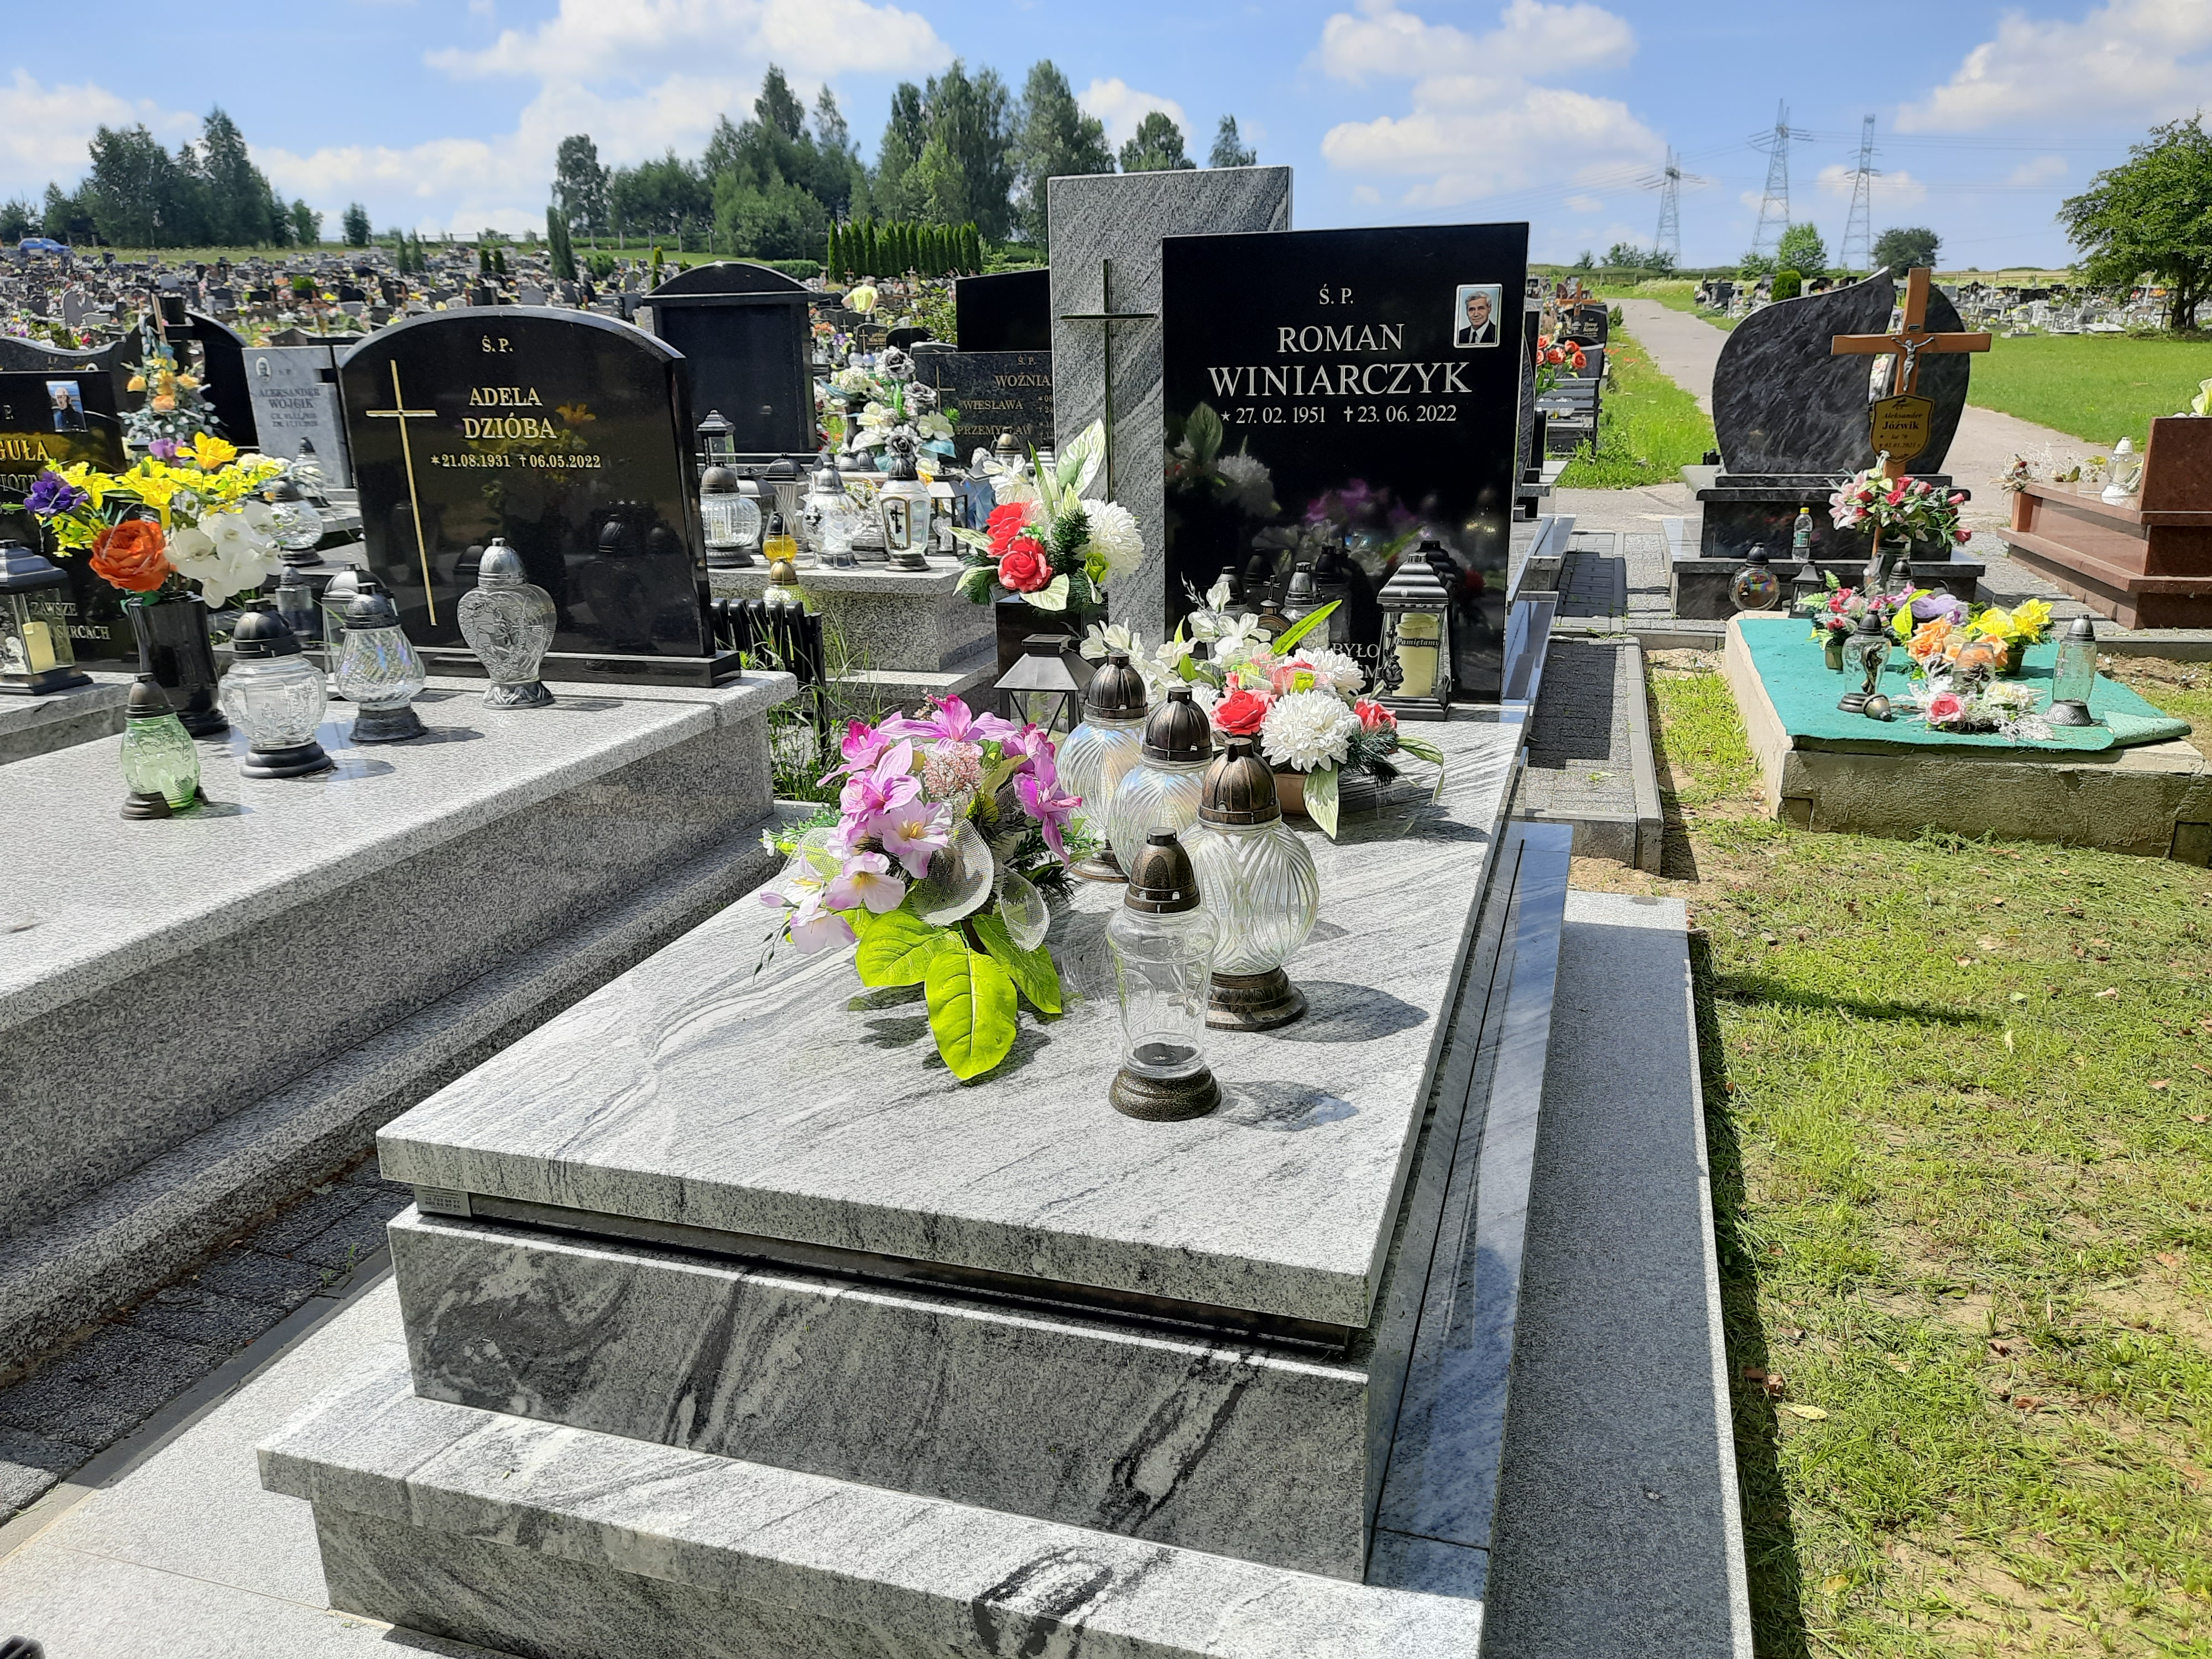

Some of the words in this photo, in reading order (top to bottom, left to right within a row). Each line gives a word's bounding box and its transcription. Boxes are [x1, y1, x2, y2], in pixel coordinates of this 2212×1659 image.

[1319, 283, 1334, 305] Ś.
[1340, 288, 1354, 305] P.
[498, 337, 514, 353] P.
[1276, 324, 1405, 353] ROMAN
[995, 372, 1052, 387] WOŹNIA
[1207, 362, 1473, 397] WINIARCZYK
[468, 387, 544, 406] ADELA
[962, 399, 1024, 410] WIESŁAWA
[1235, 408, 1257, 424] 27.
[1262, 407, 1286, 424] 02.
[1293, 406, 1326, 423] 1951
[1357, 406, 1380, 422] 23.
[1385, 405, 1410, 422] 06.
[1416, 405, 1457, 422] 2022
[462, 411, 557, 439] DZIÓBA
[956, 424, 1034, 435] PRZEMYAW
[1882, 421, 1919, 430] Jóźwik
[441, 453, 512, 468] 21.08.1931
[529, 455, 602, 468] 06.05.2022
[30, 602, 78, 617] ZAWSZE
[1331, 643, 1380, 658] BYŁO
[1396, 638, 1441, 648] Pamiętamy
